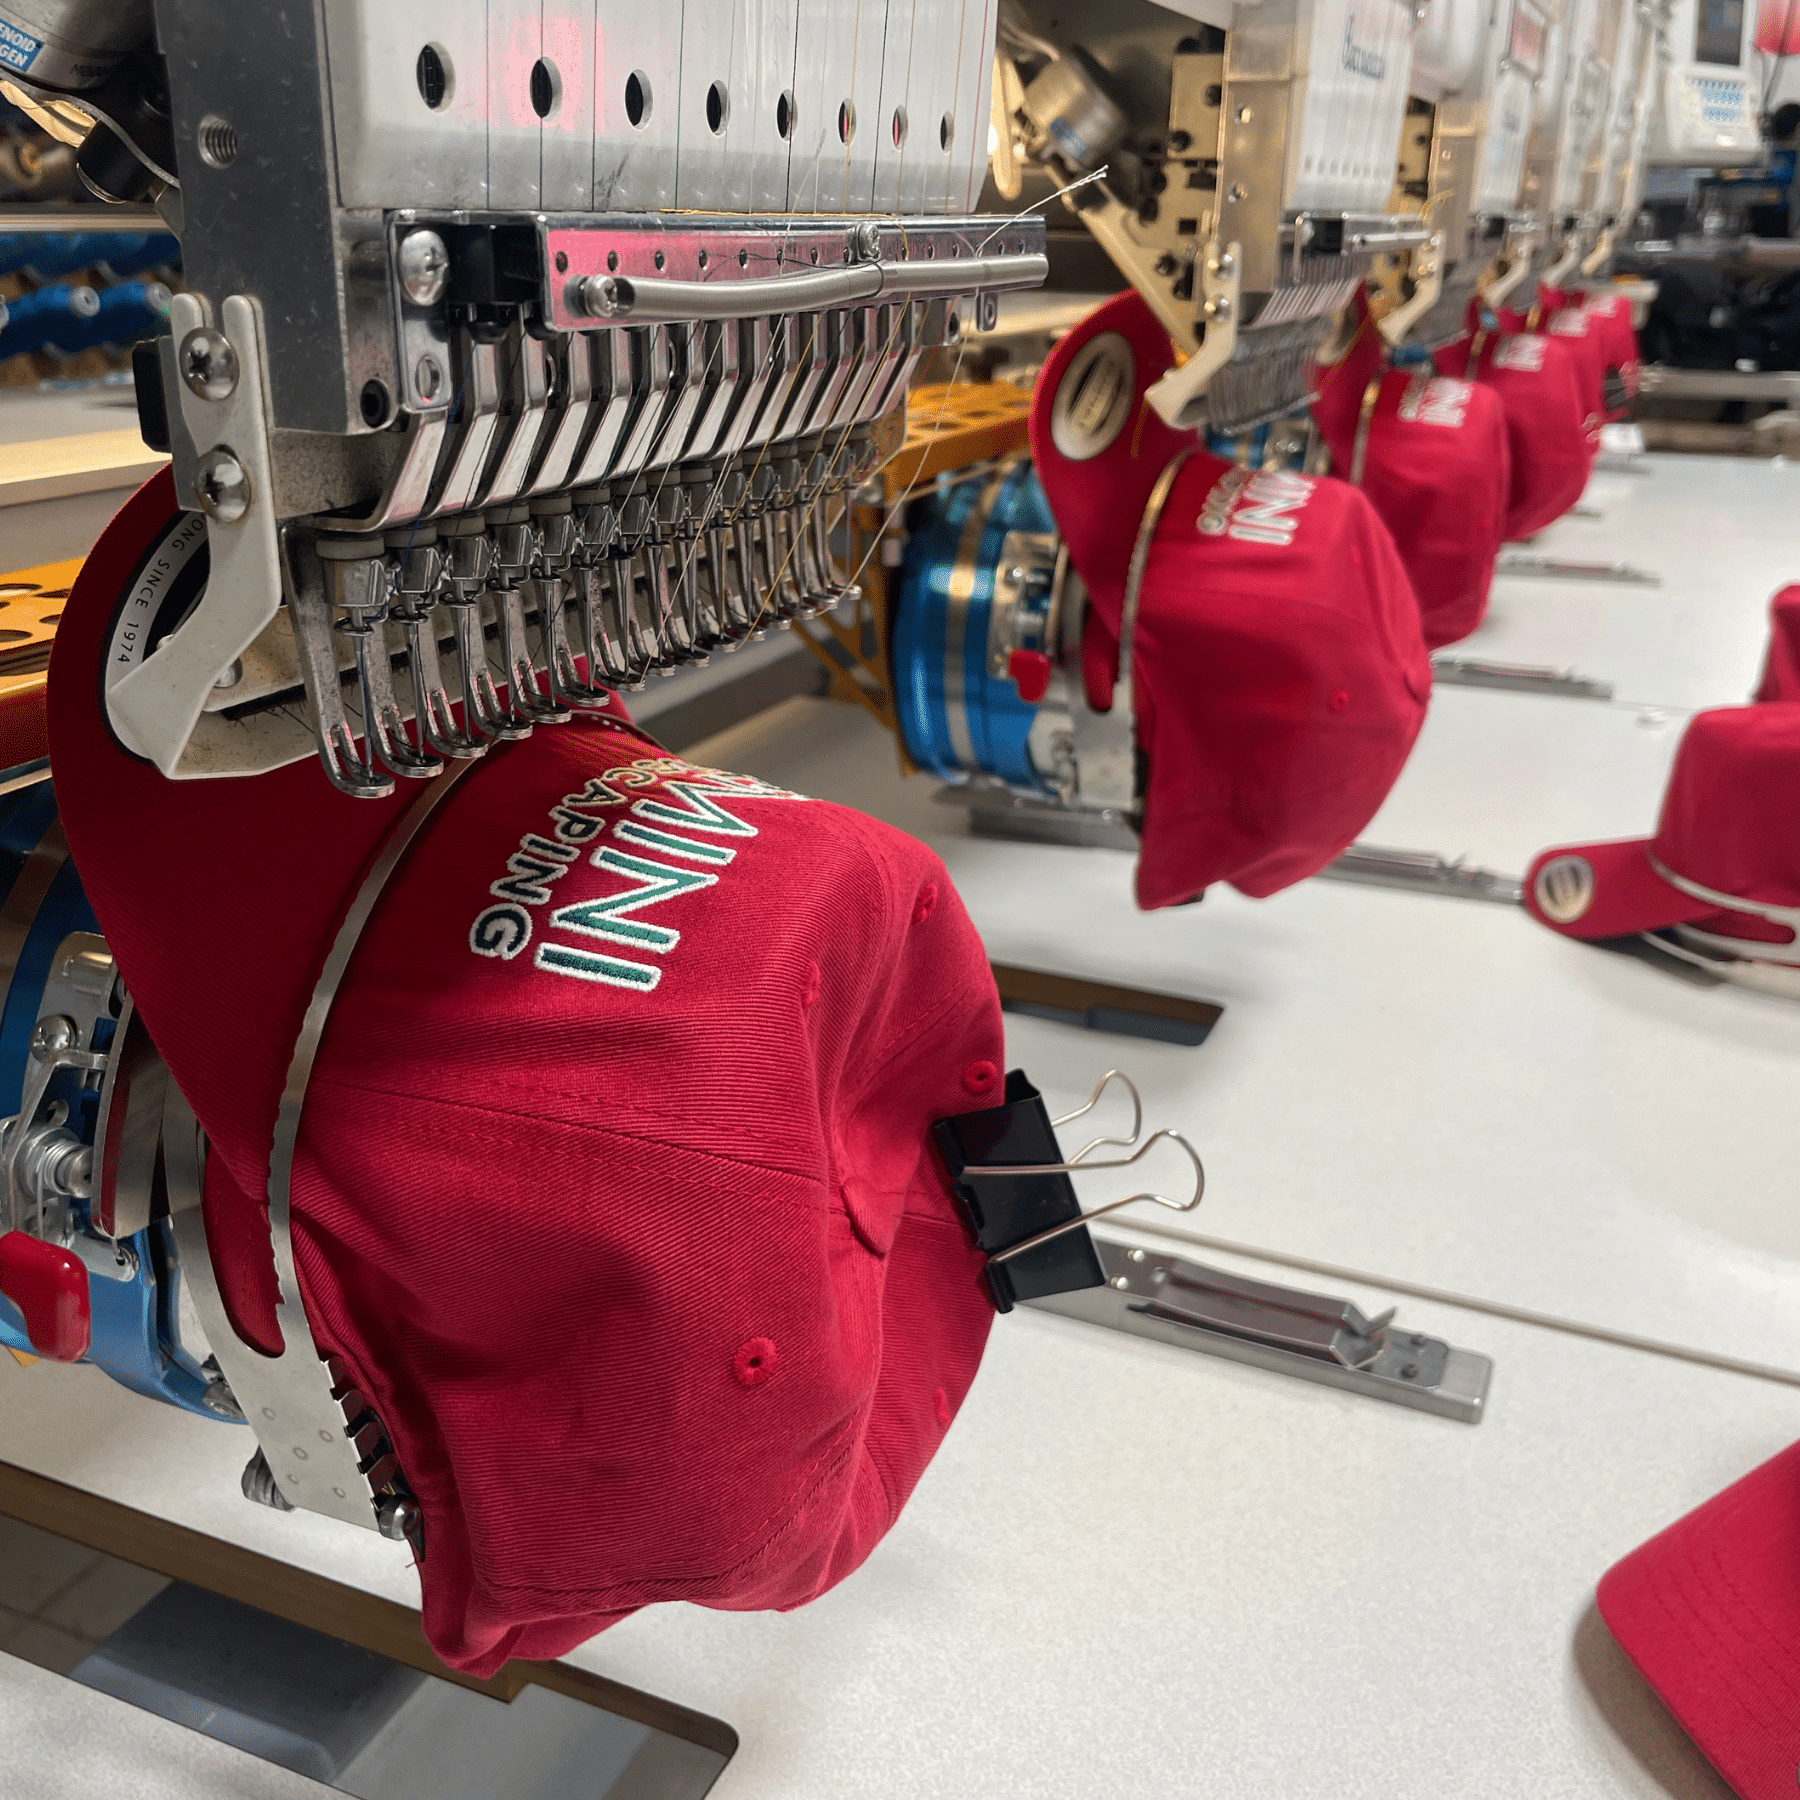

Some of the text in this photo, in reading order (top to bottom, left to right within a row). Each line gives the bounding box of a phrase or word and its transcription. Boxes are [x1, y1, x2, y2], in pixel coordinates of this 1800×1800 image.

[117, 513, 206, 663] ONG SINCE 1974
[534, 769, 812, 992] MINI
